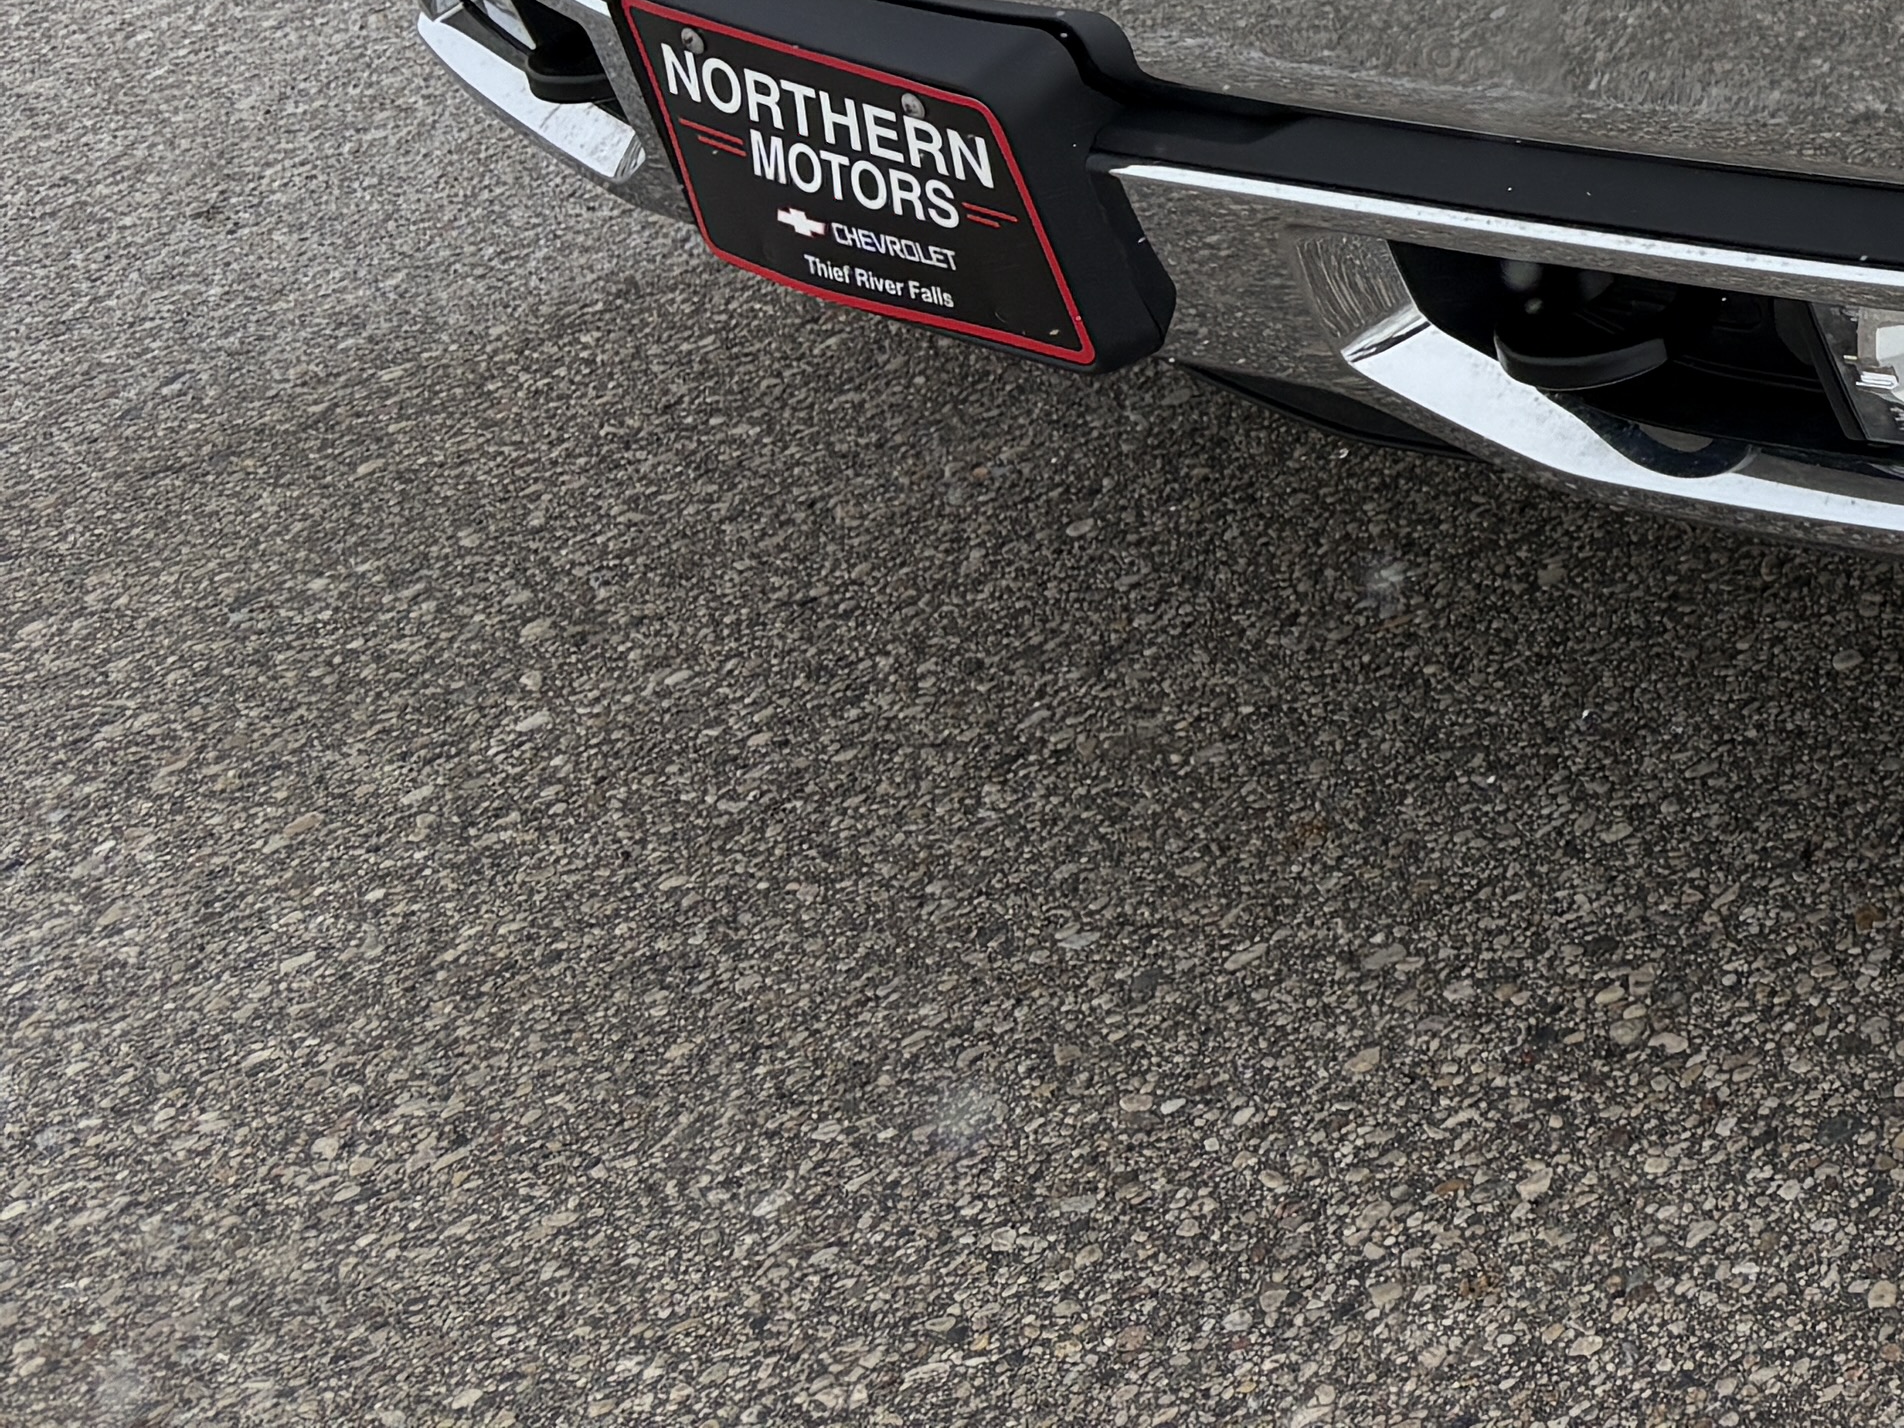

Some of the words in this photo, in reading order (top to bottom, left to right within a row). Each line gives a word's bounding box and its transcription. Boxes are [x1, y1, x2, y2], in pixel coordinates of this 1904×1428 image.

[661, 42, 995, 189] NORTHERN
[750, 128, 960, 229] MOTORS
[803, 253, 851, 284] Thief
[854, 267, 903, 296] River
[908, 280, 955, 308] Falls
[831, 222, 957, 271] CHEVROLET
